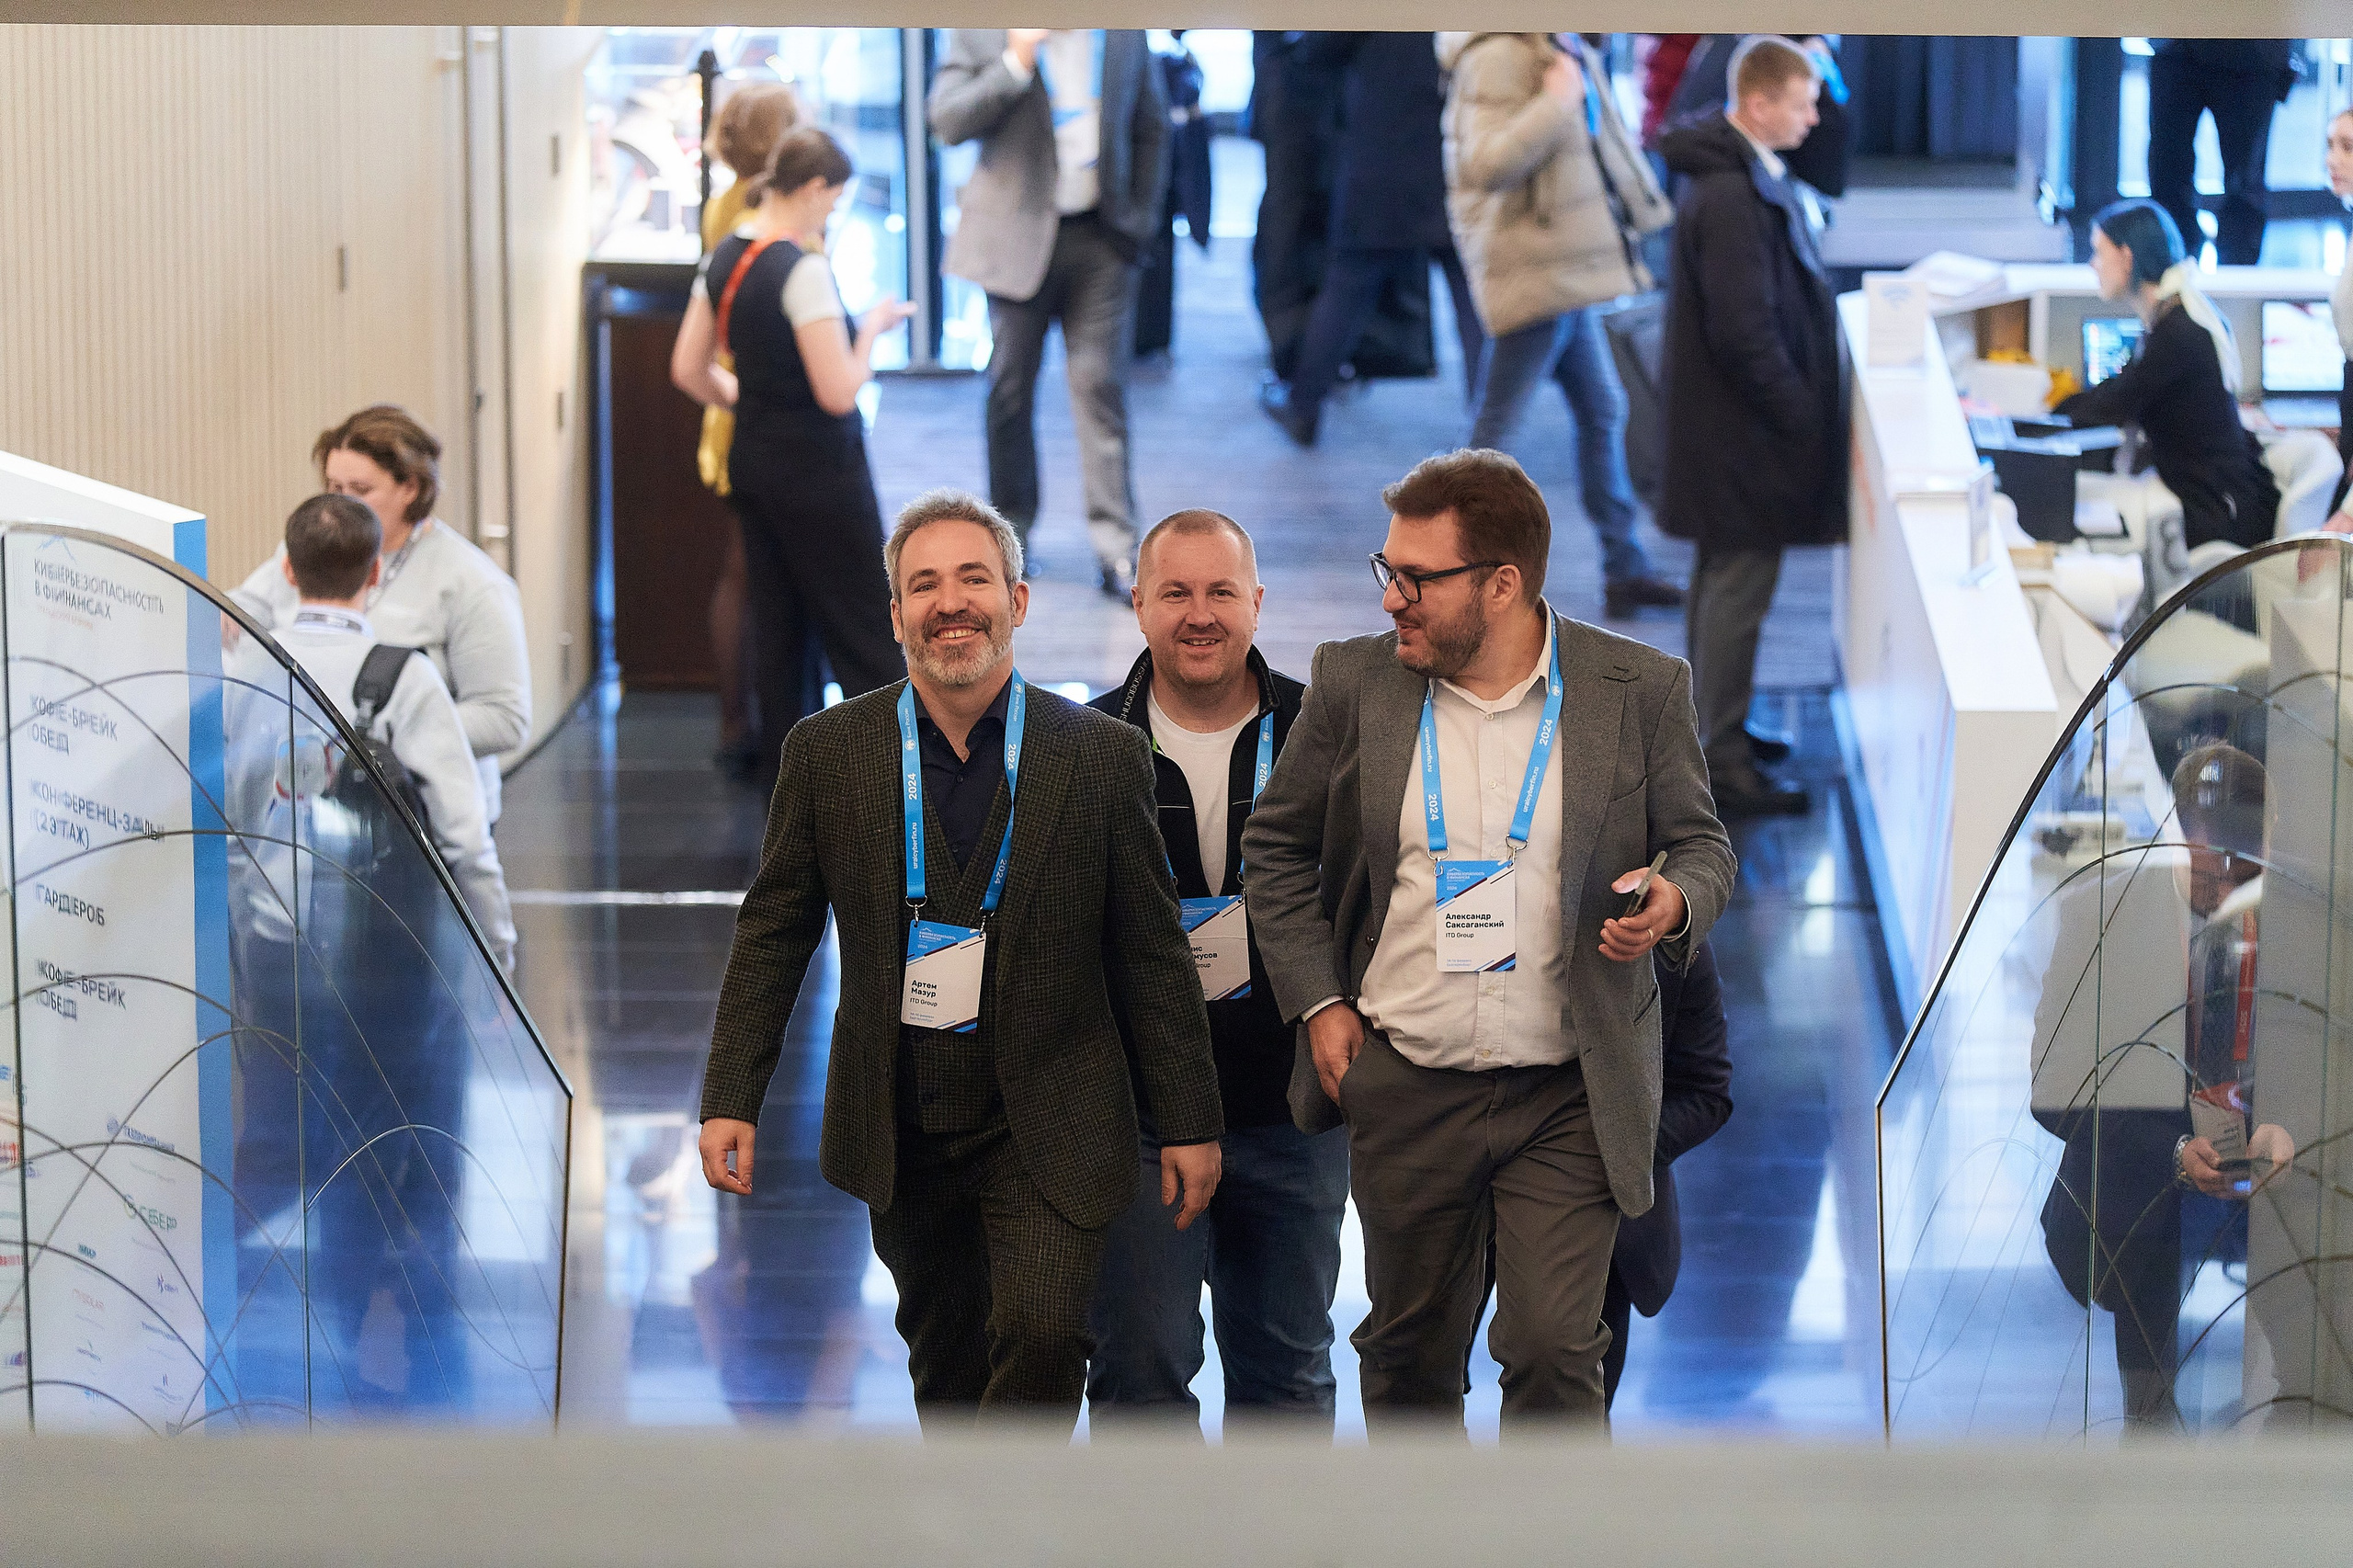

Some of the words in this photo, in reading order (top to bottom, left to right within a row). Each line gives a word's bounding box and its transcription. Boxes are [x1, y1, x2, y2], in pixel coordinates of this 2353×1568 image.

[34, 558, 164, 614] КИБЕРБЕЗОПАСНОСТЬ
[35, 579, 40, 597] В
[42, 584, 112, 621] ФИНАНСАХ
[29, 694, 118, 742] КОФЕ-БРЕЙК
[1539, 719, 1553, 746] 2024
[30, 722, 69, 756] ОБЕД
[1425, 726, 1433, 773] uralcyberfin.ru
[1007, 744, 1017, 771] 2024
[907, 773, 917, 801] 2024
[1258, 762, 1268, 788] 2024
[1522, 766, 1540, 813] uralcyberfin.ru
[1428, 793, 1439, 822] 2024
[994, 858, 1008, 885] 2024
[36, 882, 105, 926] ГАРДЕРОБ
[1446, 920, 1505, 928] Саксаганский
[37, 959, 126, 1010] КОФЕ-БРЕЙК
[911, 988, 937, 998] Мазур
[912, 980, 937, 990] Артем
[37, 989, 77, 1022] ОБЕД
[920, 999, 938, 1007] Group
